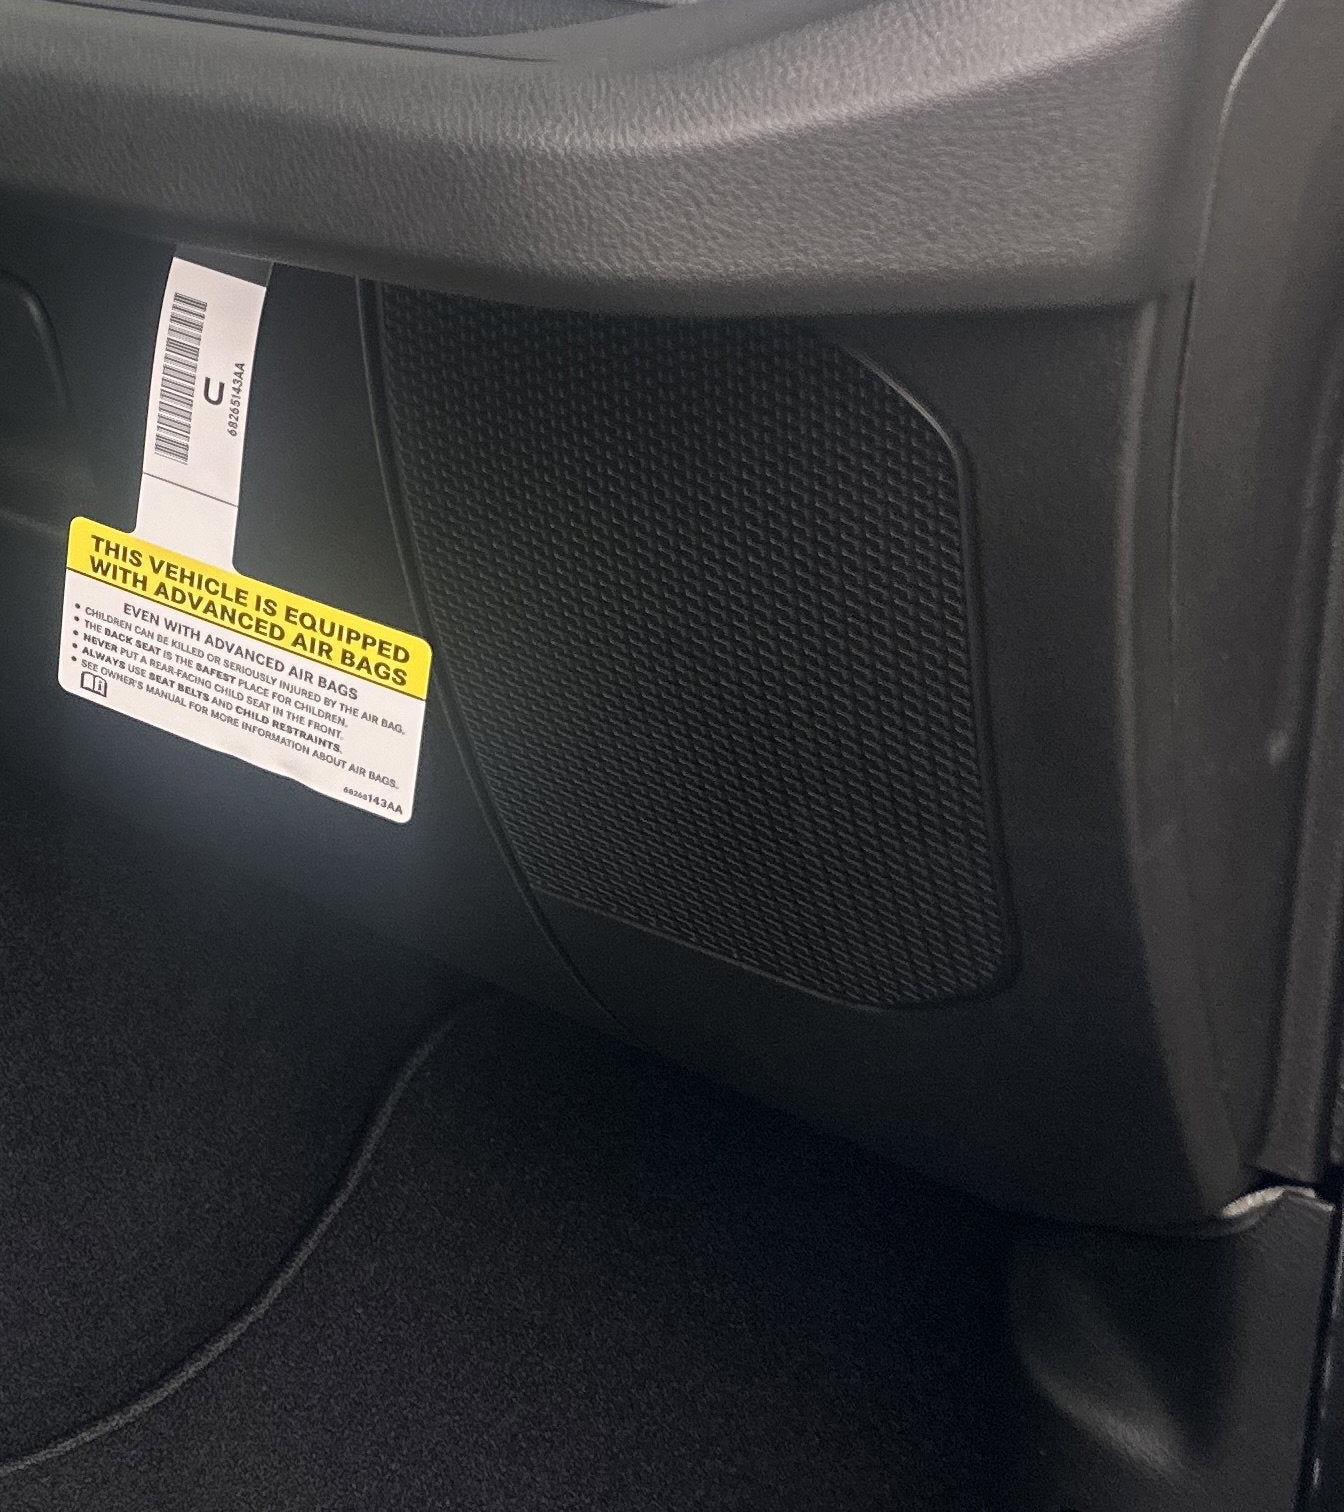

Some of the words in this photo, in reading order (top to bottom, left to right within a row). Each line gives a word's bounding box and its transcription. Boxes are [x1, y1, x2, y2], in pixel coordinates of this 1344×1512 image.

[203, 376, 225, 406] U
[226, 362, 245, 437] 68265143AA
[88, 554, 148, 592] WITH
[153, 579, 284, 643] ADVANCED
[291, 629, 332, 661] AIR
[336, 646, 408, 688] BAGS
[90, 534, 143, 569] THIS
[148, 555, 249, 608] VEHICLE
[255, 594, 278, 618] IS
[284, 605, 410, 666] EQUIPPED
[123, 602, 159, 626] EVEN
[163, 617, 200, 642] WITH
[204, 632, 285, 674] ADVANCED
[288, 664, 313, 685] AIR
[317, 675, 358, 701] BAGS
[82, 646, 125, 670] ALWAYS
[127, 663, 146, 678] USE
[148, 671, 174, 689] SEAT
[177, 682, 210, 703] BELTS
[211, 695, 233, 711] AND
[235, 704, 269, 725] CHILD
[272, 719, 342, 753] RESTRAINTS.
[83, 633, 117, 653] NEVER
[120, 646, 138, 661] PUT
[140, 654, 147, 665] A
[149, 658, 211, 689] REAR-FACING
[213, 682, 243, 702] CHILD
[246, 695, 270, 712] SEAT
[272, 705, 283, 717] IN
[286, 710, 305, 725] THE
[84, 619, 102, 634] THE
[104, 627, 133, 645] BACK
[135, 638, 161, 656] SEAT
[174, 653, 193, 668] THE
[195, 661, 236, 684] SAFEST
[238, 677, 269, 697] PLACE
[272, 690, 292, 706] FOR
[84, 606, 131, 631] CHILDREN
[134, 624, 155, 640] CAN
[157, 633, 169, 646] BE
[171, 638, 203, 659] KILLED
[206, 651, 220, 665] OR
[223, 658, 277, 686] SERIOUSLY
[279, 679, 321, 703] INJURED
[323, 696, 337, 709] BY
[339, 702, 359, 717] THE
[361, 710, 379, 725] AIR
[80, 658, 98, 674] SEE
[100, 666, 143, 691] OWNER'S
[146, 684, 187, 708] MANUAL
[189, 700, 208, 716] FOR
[210, 709, 239, 728] MORE
[241, 721, 309, 755] INFORMATION
[312, 748, 346, 769] ABOUT
[348, 762, 366, 777] AIR
